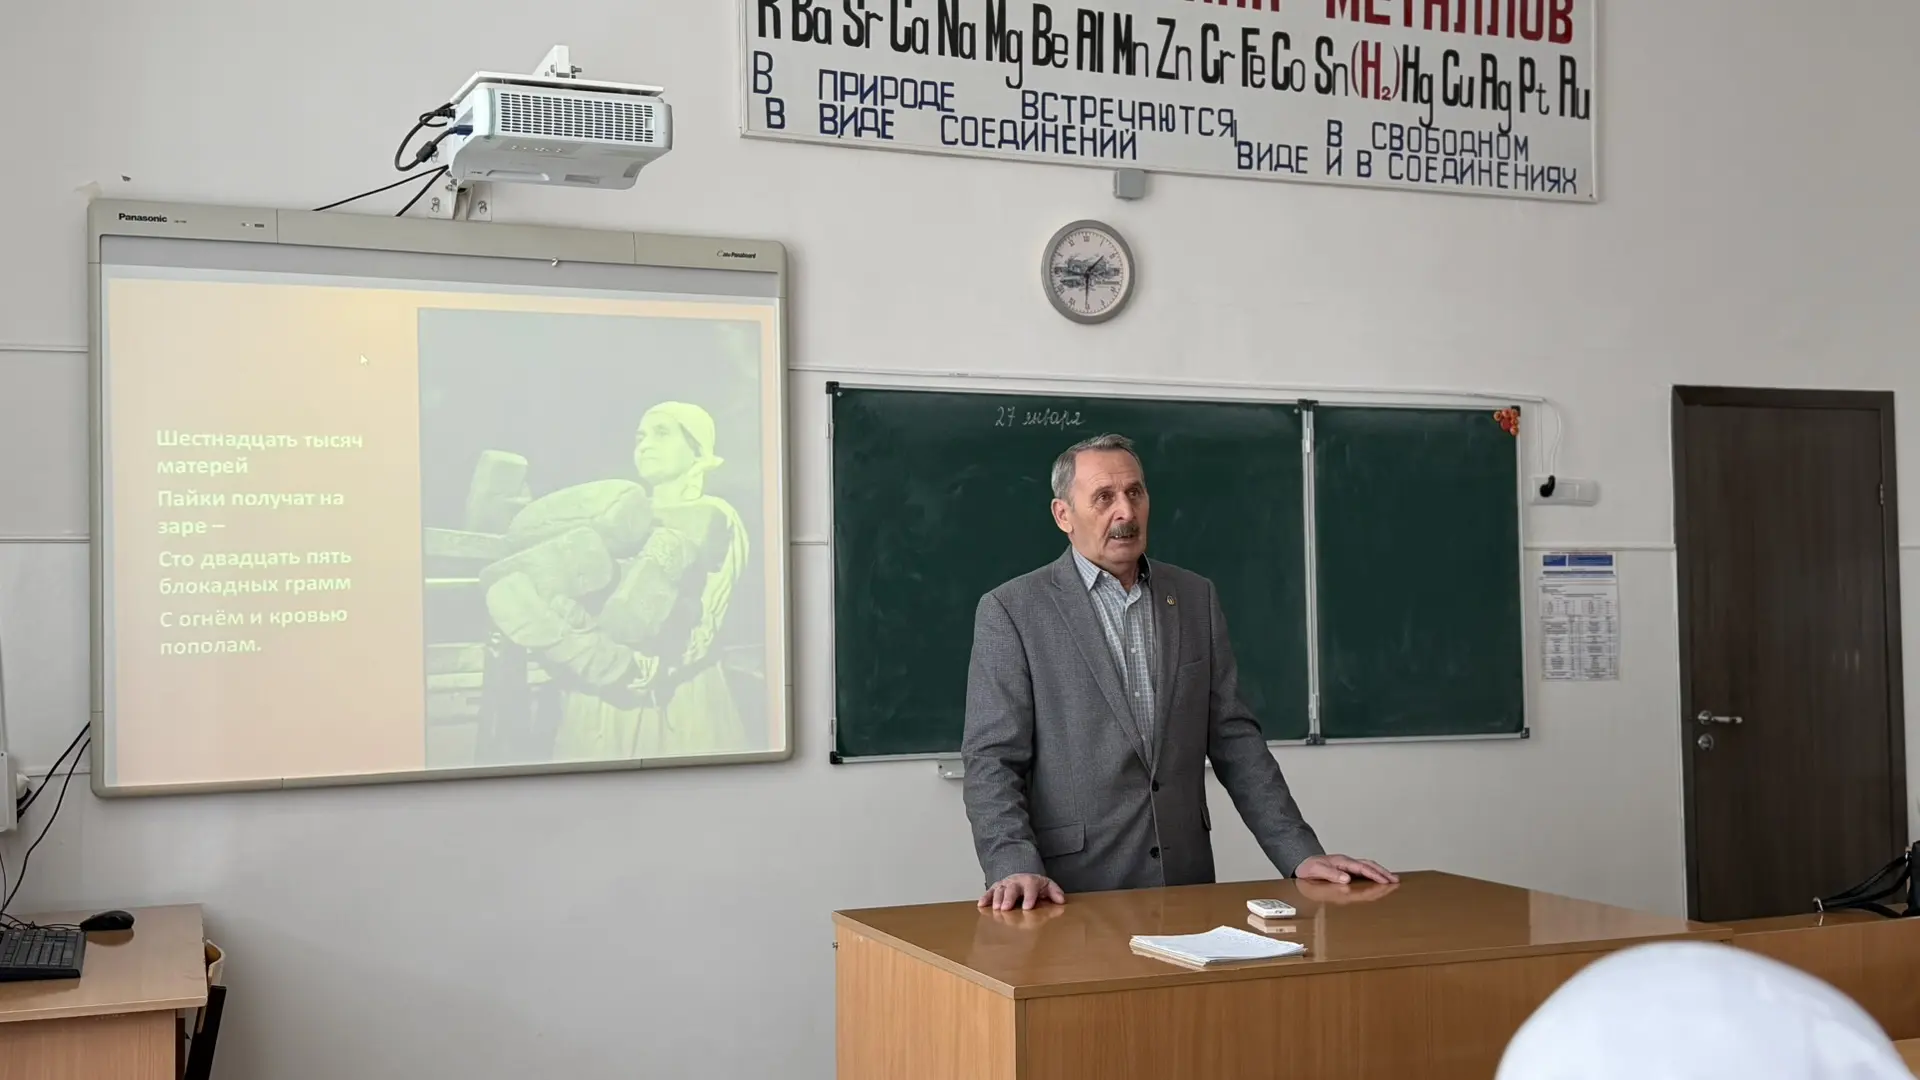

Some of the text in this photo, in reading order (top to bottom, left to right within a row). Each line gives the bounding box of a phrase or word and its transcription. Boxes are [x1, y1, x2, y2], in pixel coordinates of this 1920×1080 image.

[792, 0, 832, 45] Ba
[842, 0, 883, 48] Sr
[890, 0, 929, 55] Ca
[938, 0, 976, 60] Na
[985, 0, 1023, 89] Mg
[1032, 3, 1068, 68] Be
[1076, 8, 1104, 73] Al
[1113, 12, 1149, 77] Mn
[1156, 17, 1192, 81] Zn
[1201, 23, 1236, 84] Cr
[1242, 27, 1266, 88] Fe
[1272, 31, 1305, 92] Co
[1314, 36, 1348, 96] Sn
[1401, 44, 1433, 128] Hg
[1442, 49, 1474, 108] Cu
[1480, 53, 1512, 134] Ag
[1519, 56, 1549, 115] Pt
[1559, 55, 1590, 120] Au
[752, 50, 774, 94] В
[818, 68, 955, 112] ПРИРОДЕ
[765, 97, 1137, 160] В ВИДЕ СОЕДИНЕНИЙ
[1326, 119, 1529, 162] В СВОБОДНОМ
[1237, 140, 1577, 194] ВИДЕ И В СОЕДИНЕНИЯХ
[118, 212, 168, 223] Panasonic
[995, 406, 1085, 431] 27 января
[156, 429, 363, 450] Шестнадцать тысяч
[156, 457, 248, 477] матерей
[157, 489, 344, 509] Пайки получат на
[157, 520, 208, 537] заре
[158, 550, 352, 569] Сто двадцать пять
[159, 577, 352, 596] блокадных грамм
[160, 608, 348, 628] С огнём и кровью
[160, 639, 262, 656] пополам.
